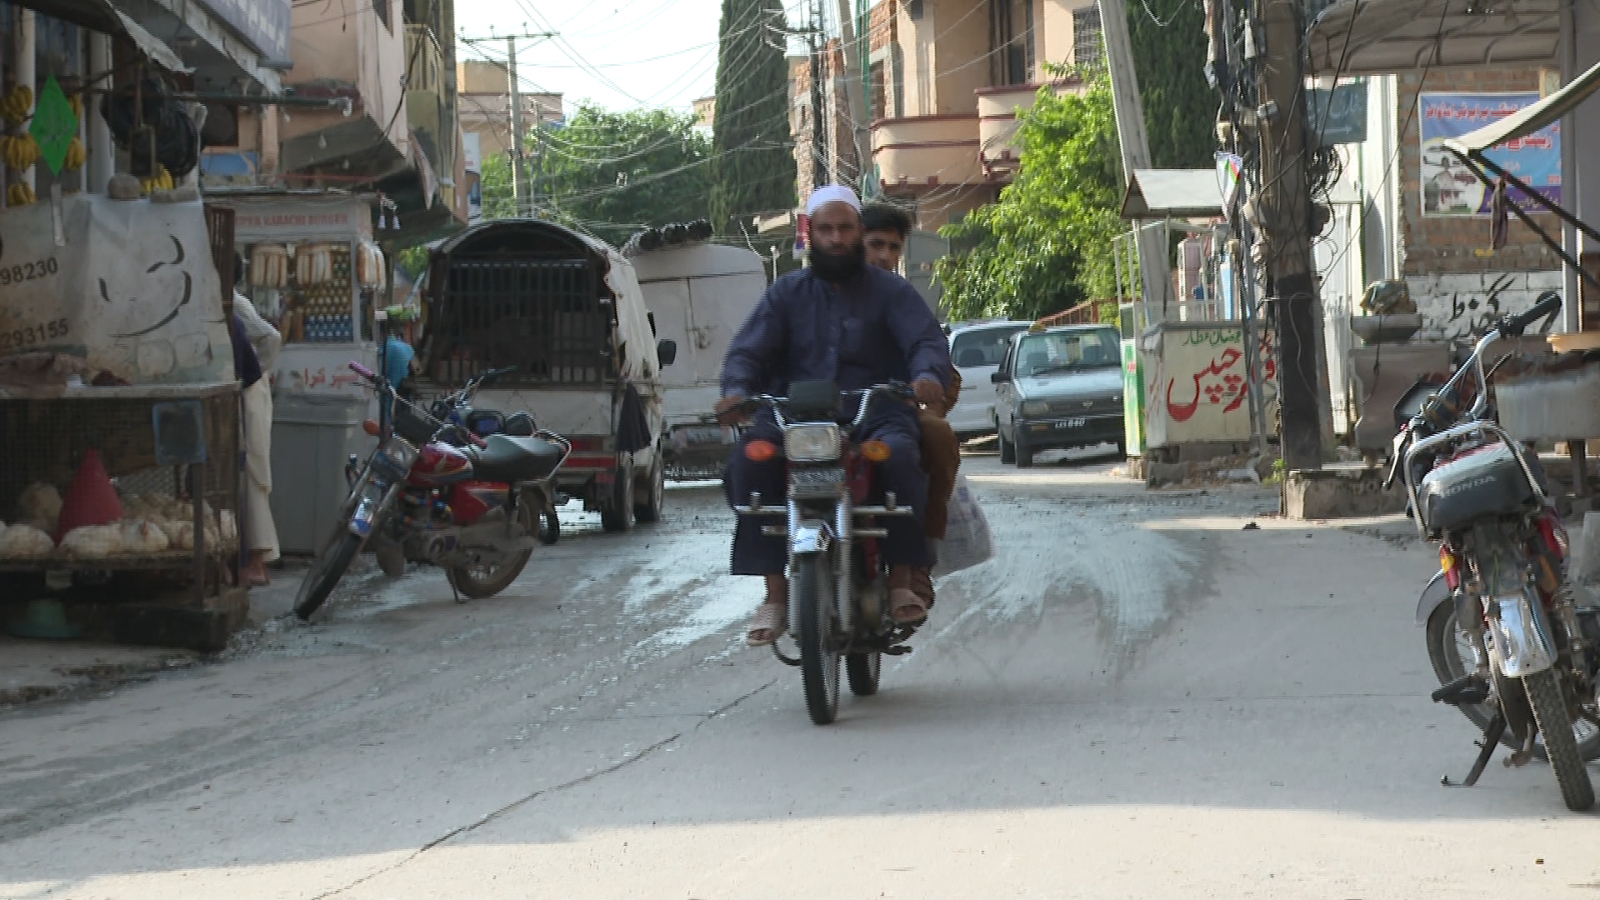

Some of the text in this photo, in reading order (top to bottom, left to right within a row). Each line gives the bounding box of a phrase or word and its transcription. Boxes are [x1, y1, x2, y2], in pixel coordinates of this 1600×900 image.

[264, 214, 306, 225] KARACHI
[308, 212, 347, 225] BURGER
[1440, 475, 1495, 498] HONDA
